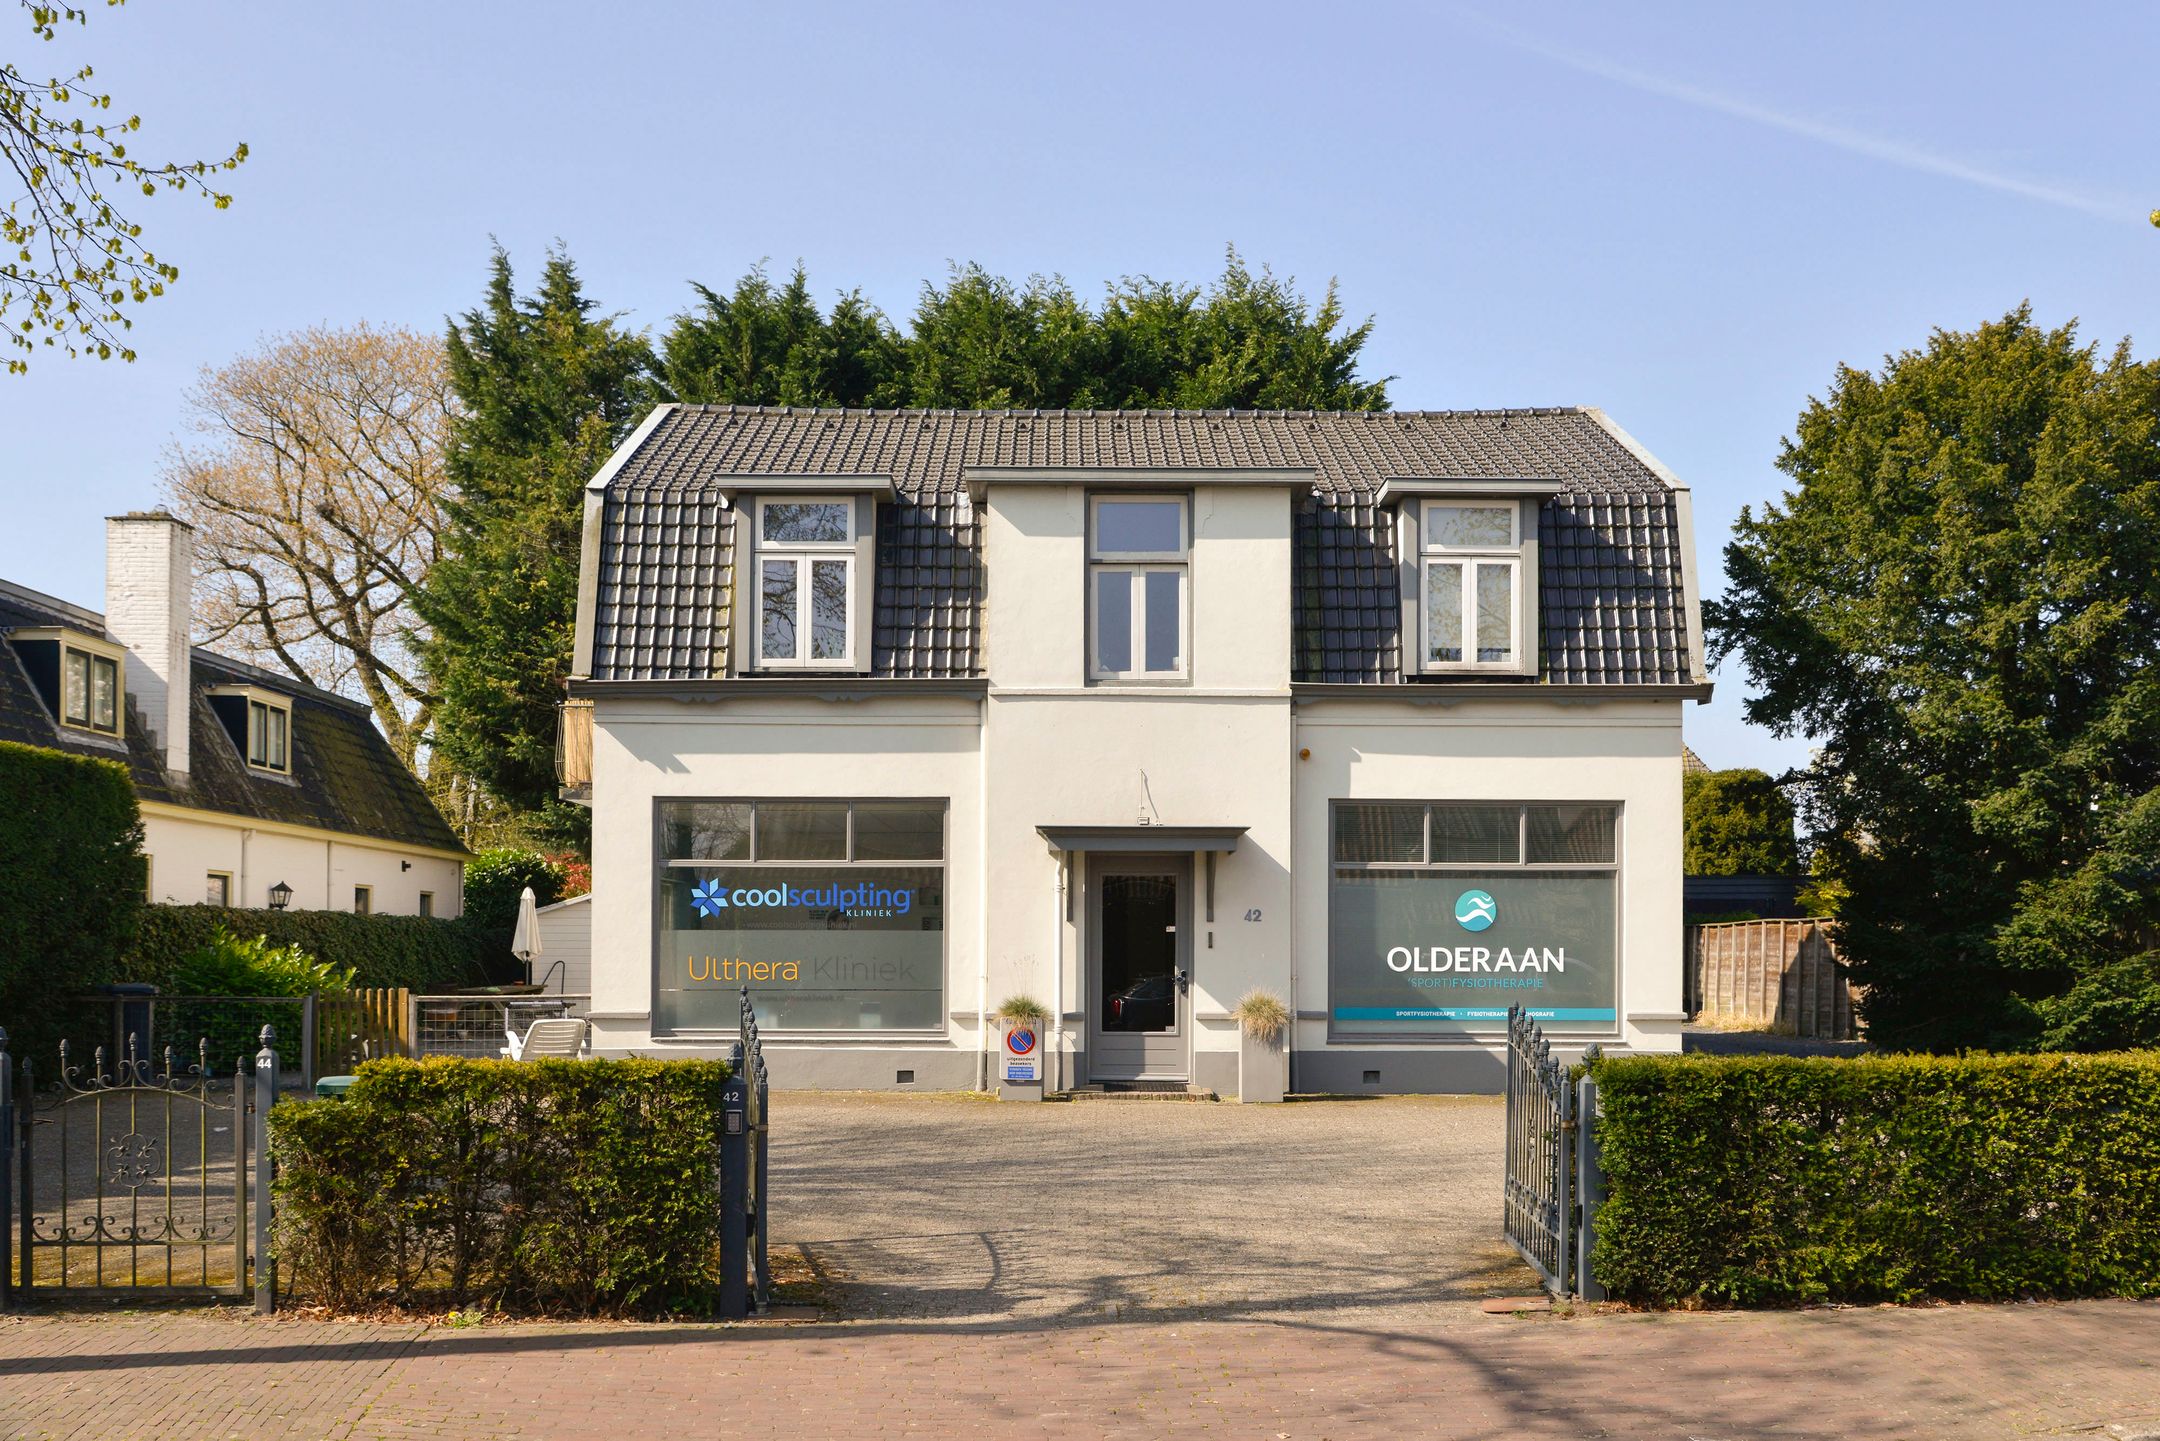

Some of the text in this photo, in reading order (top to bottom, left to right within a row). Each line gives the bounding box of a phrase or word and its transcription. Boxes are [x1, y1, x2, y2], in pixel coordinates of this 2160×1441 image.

[731, 881, 912, 914] coolsculpting
[846, 909, 892, 917] KLINIEK
[1243, 908, 1262, 922] 42
[1386, 946, 1565, 973] OLDERAAN
[688, 955, 916, 982] Ulthera Kliniek
[257, 1058, 272, 1068] 44
[723, 1091, 739, 1102] 42
